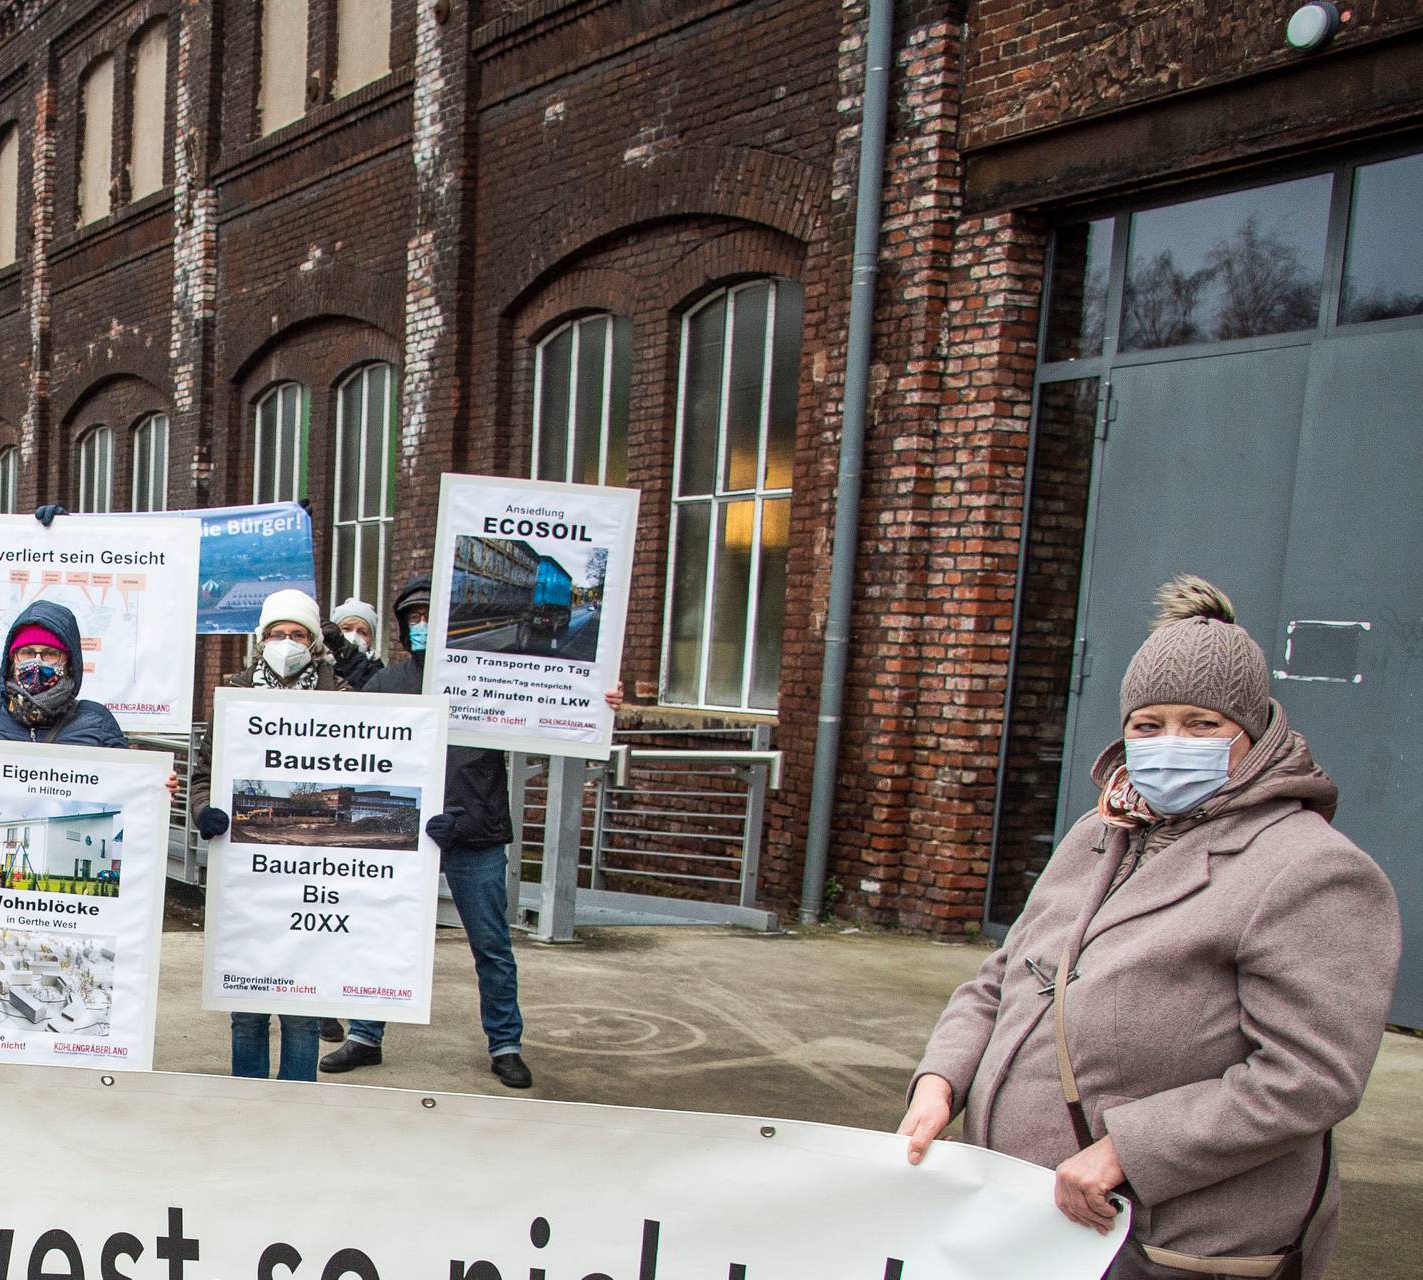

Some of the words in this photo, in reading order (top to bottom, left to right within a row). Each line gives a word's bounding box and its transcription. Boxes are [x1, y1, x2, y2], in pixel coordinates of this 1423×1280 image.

[505, 504, 565, 519] Ansiedlung
[200, 521, 221, 537] ie
[227, 511, 302, 536] Bürger!
[483, 517, 592, 542] ECOSOIL
[60, 550, 94, 564] sein
[100, 551, 165, 565] Gesicht
[446, 654, 468, 664] 300
[476, 656, 541, 671] Transporte
[544, 664, 563, 673] pro
[568, 665, 590, 677] Tag
[531, 681, 572, 691] entspricht
[443, 686, 467, 696] Alle
[471, 689, 479, 697] 2
[483, 689, 533, 702] Minuten
[537, 696, 556, 705] ein
[561, 697, 590, 707] LKW
[449, 705, 505, 716] rgerinitiative
[248, 716, 412, 741] Schulzentrum
[501, 717, 527, 726] nicht!
[265, 749, 393, 773] Baustelle
[3, 764, 99, 785] Eigenheime
[28, 785, 37, 794] in
[39, 786, 72, 797] Hiltrop
[252, 854, 394, 879] Bauarbeiten
[303, 885, 340, 904] Bis
[6, 915, 16, 924] in
[18, 916, 50, 927] Gerthe
[52, 919, 77, 929] West
[290, 912, 350, 933] 20XX
[223, 974, 295, 987] Bürgerinitiative
[223, 983, 248, 992] Gerthe
[250, 984, 270, 992] West
[275, 985, 288, 993] so
[290, 985, 317, 995] nicht!
[1, 1040, 26, 1050] nicht!
